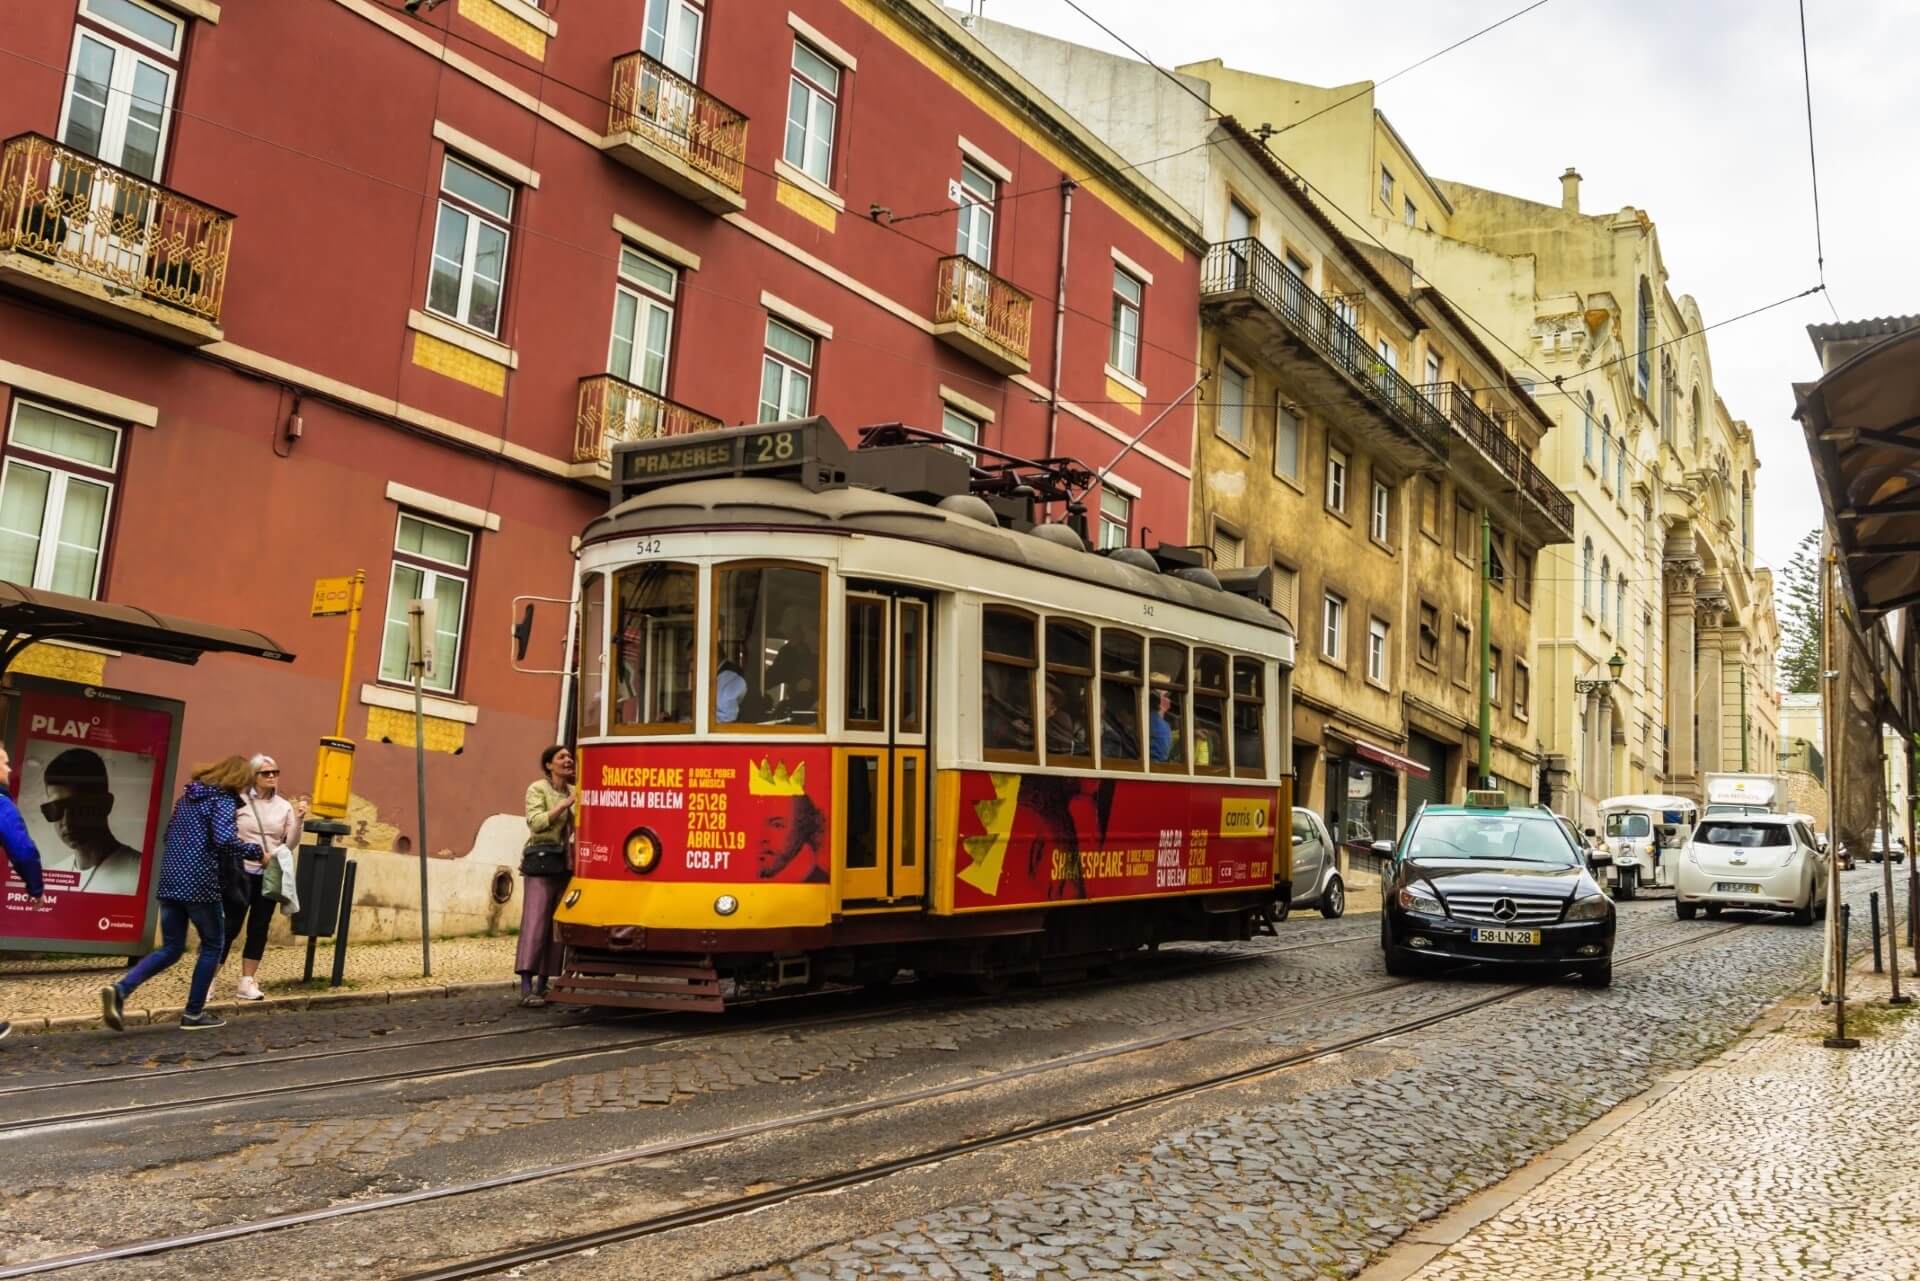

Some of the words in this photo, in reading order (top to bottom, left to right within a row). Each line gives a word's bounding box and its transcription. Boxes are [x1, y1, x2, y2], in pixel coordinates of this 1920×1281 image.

[757, 431, 793, 463] 28
[634, 446, 731, 474] PRAZERES
[637, 540, 661, 555] 542
[1143, 604, 1154, 617] 542
[31, 714, 90, 739] PLAY
[602, 765, 684, 788] SHAKESPEARE
[695, 767, 712, 778] DOCE
[714, 768, 736, 779] PODER
[599, 787, 629, 807] MÚSICA
[631, 791, 645, 809] EM
[648, 789, 683, 809] BELÉM
[1226, 806, 1250, 827] carris
[686, 850, 730, 870] CCB.PT
[1156, 868, 1166, 888] EM
